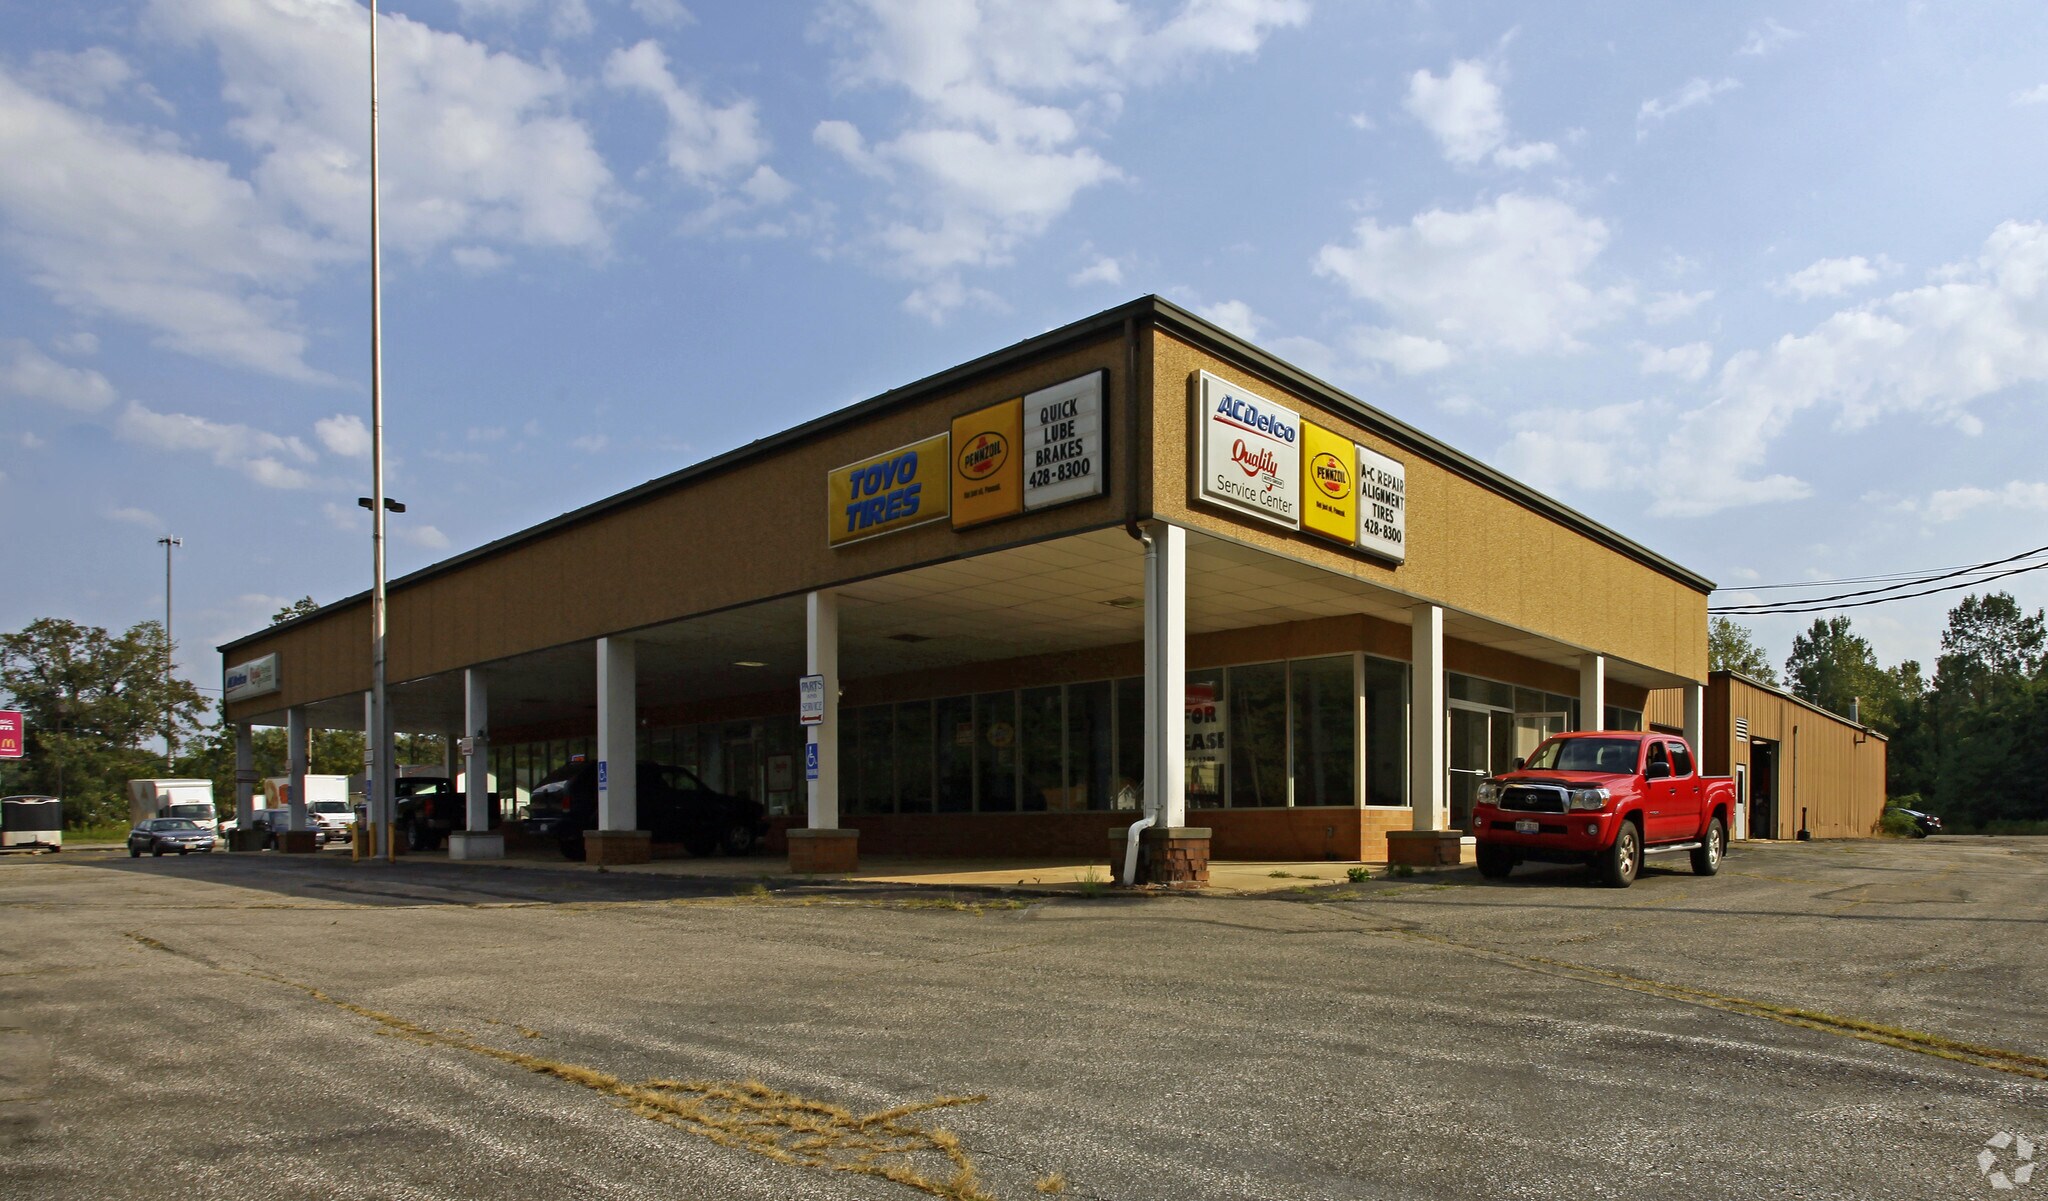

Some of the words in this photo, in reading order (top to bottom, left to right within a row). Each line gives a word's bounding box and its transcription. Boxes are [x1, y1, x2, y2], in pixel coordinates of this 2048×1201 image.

[1040, 398, 1078, 425] QUICK
[1216, 394, 1296, 443] ACDelco
[1044, 419, 1075, 444] LUBE
[964, 440, 1001, 469] PENNZOIL
[1036, 438, 1083, 468] BRAKES
[1231, 438, 1278, 492] Quality
[849, 451, 918, 499] TOYO
[1029, 457, 1091, 488] 428-8300
[1316, 466, 1347, 485] PENNZOIL
[1361, 464, 1376, 481] A-C
[1377, 468, 1404, 493] REPAIR
[846, 482, 922, 532] TIRES
[1217, 475, 1256, 502] Service
[1260, 489, 1292, 514] Center
[1361, 484, 1404, 511] ALIGNMENT
[1372, 503, 1394, 524] TIRES
[1364, 519, 1402, 544] 428-8300
[801, 681, 823, 692] PARTS
[801, 701, 822, 712] SERVICE
[1185, 732, 1225, 750] EASE
